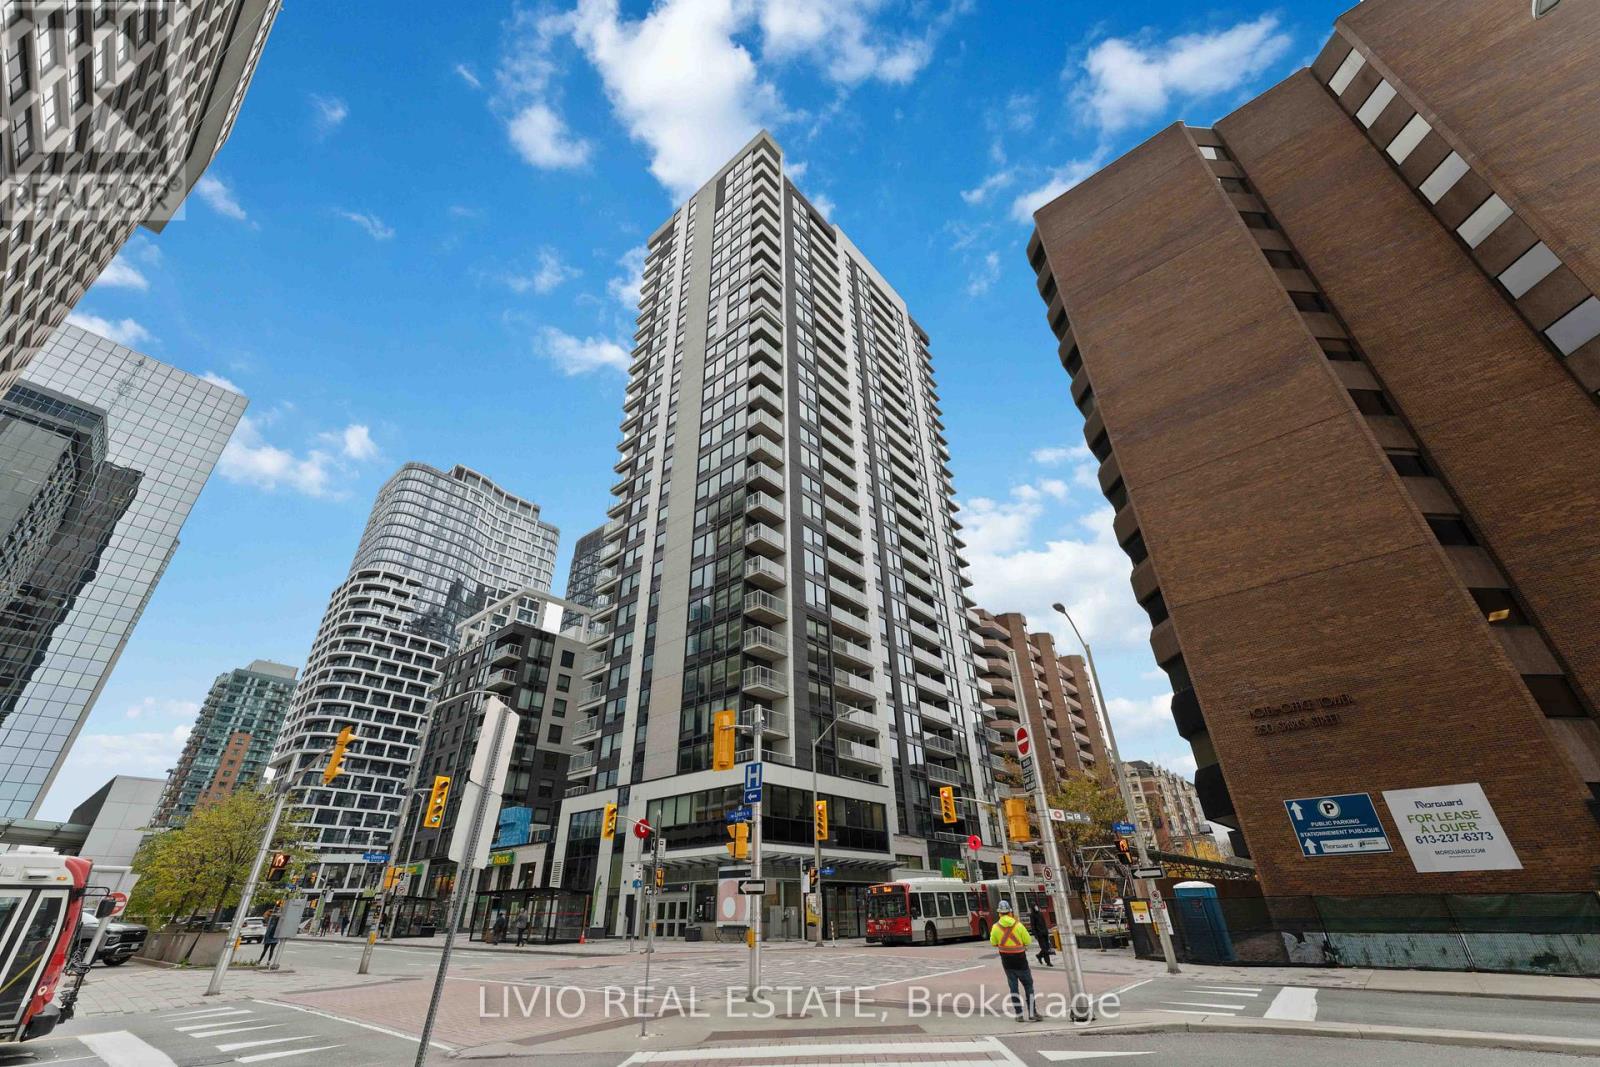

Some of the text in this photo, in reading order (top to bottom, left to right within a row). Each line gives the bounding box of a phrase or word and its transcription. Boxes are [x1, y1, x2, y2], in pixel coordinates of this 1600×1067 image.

[747, 764, 761, 788] H
[1322, 802, 1335, 815] P
[1407, 809, 1482, 824] FOR LEASE
[1299, 827, 1380, 838] STATIONNEMENT PUBLIQUE
[1431, 821, 1480, 833] LOUER
[1415, 831, 1494, 845] 613-237-6373
